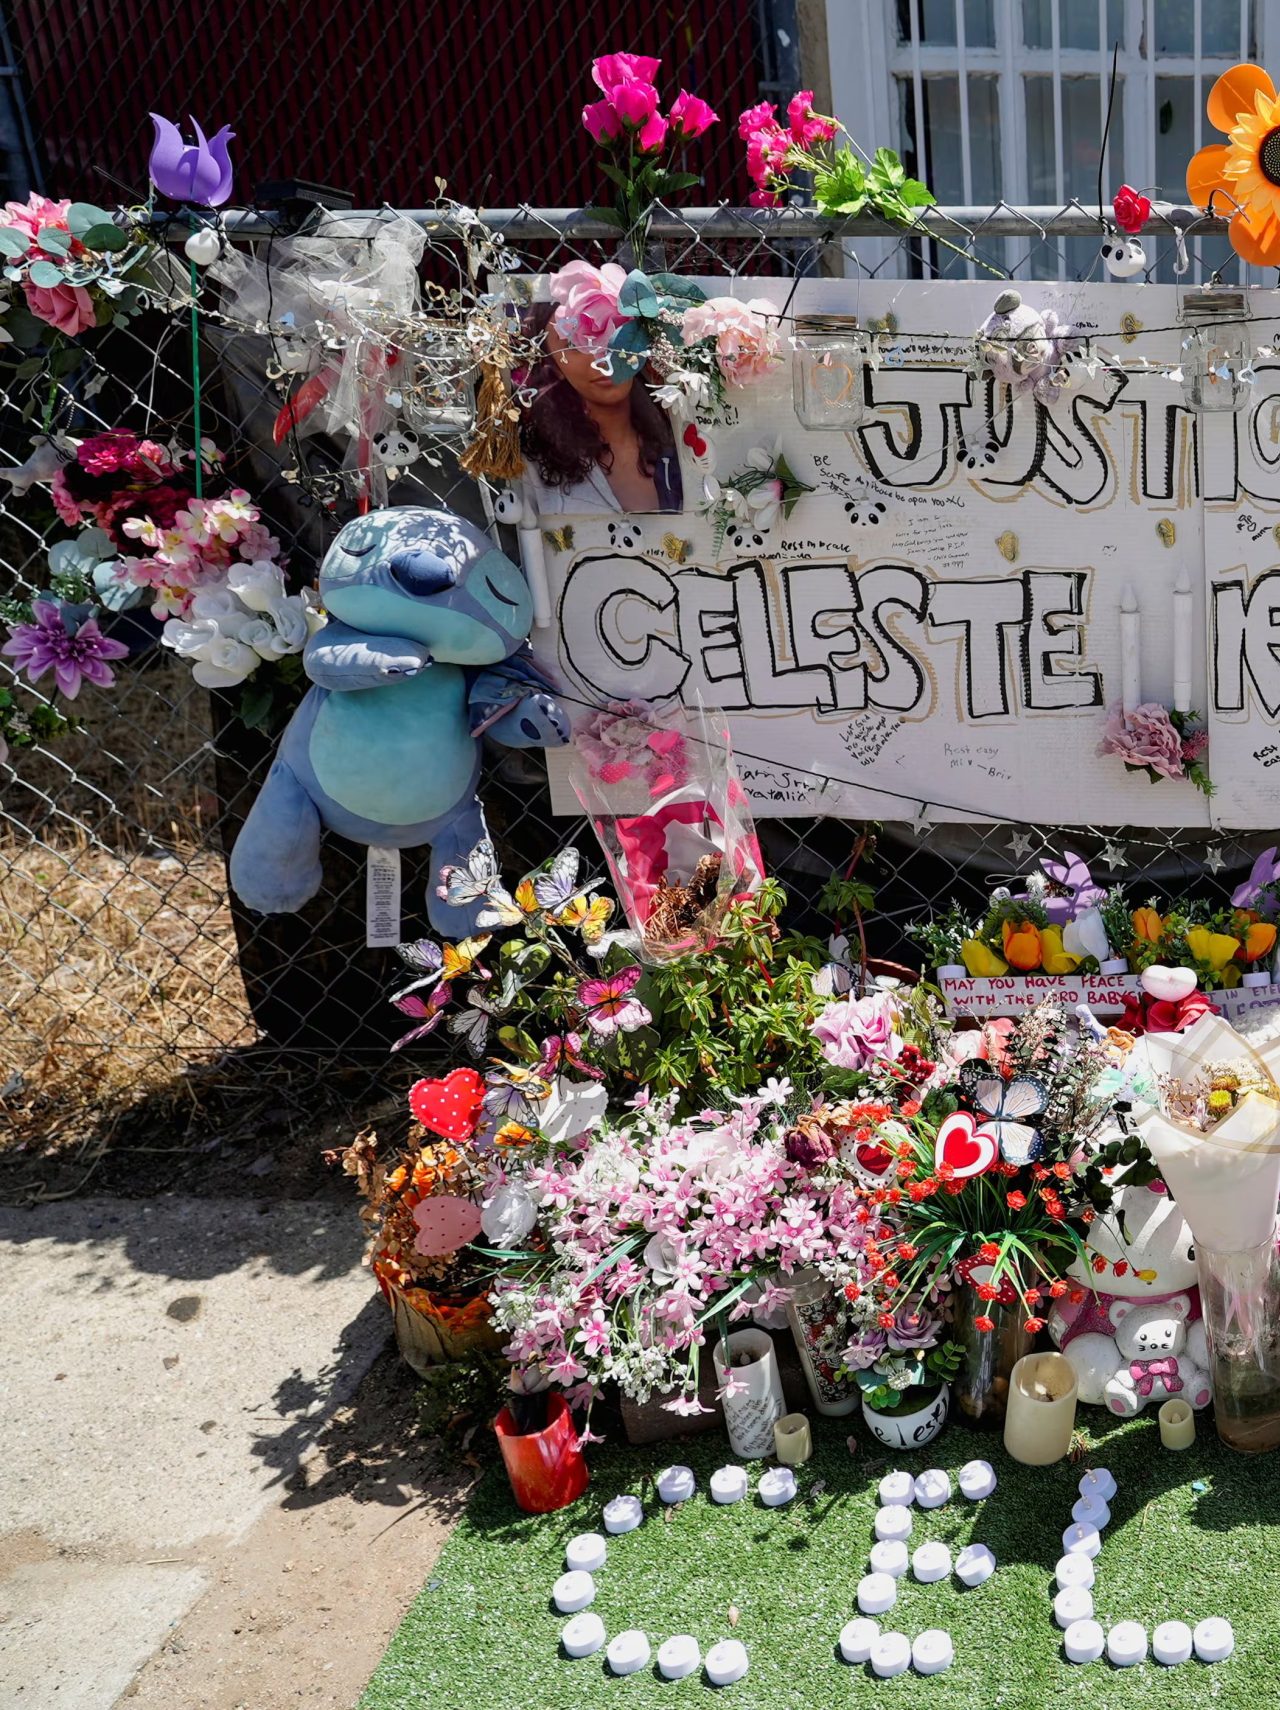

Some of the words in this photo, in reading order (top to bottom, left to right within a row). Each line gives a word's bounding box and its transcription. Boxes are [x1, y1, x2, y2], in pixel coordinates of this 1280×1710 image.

[558, 554, 1103, 719] CELESTE
[944, 978, 976, 992] MAY
[988, 977, 1016, 990] YOU
[1081, 975, 1126, 989] PEACE
[953, 992, 996, 1006] WITH
